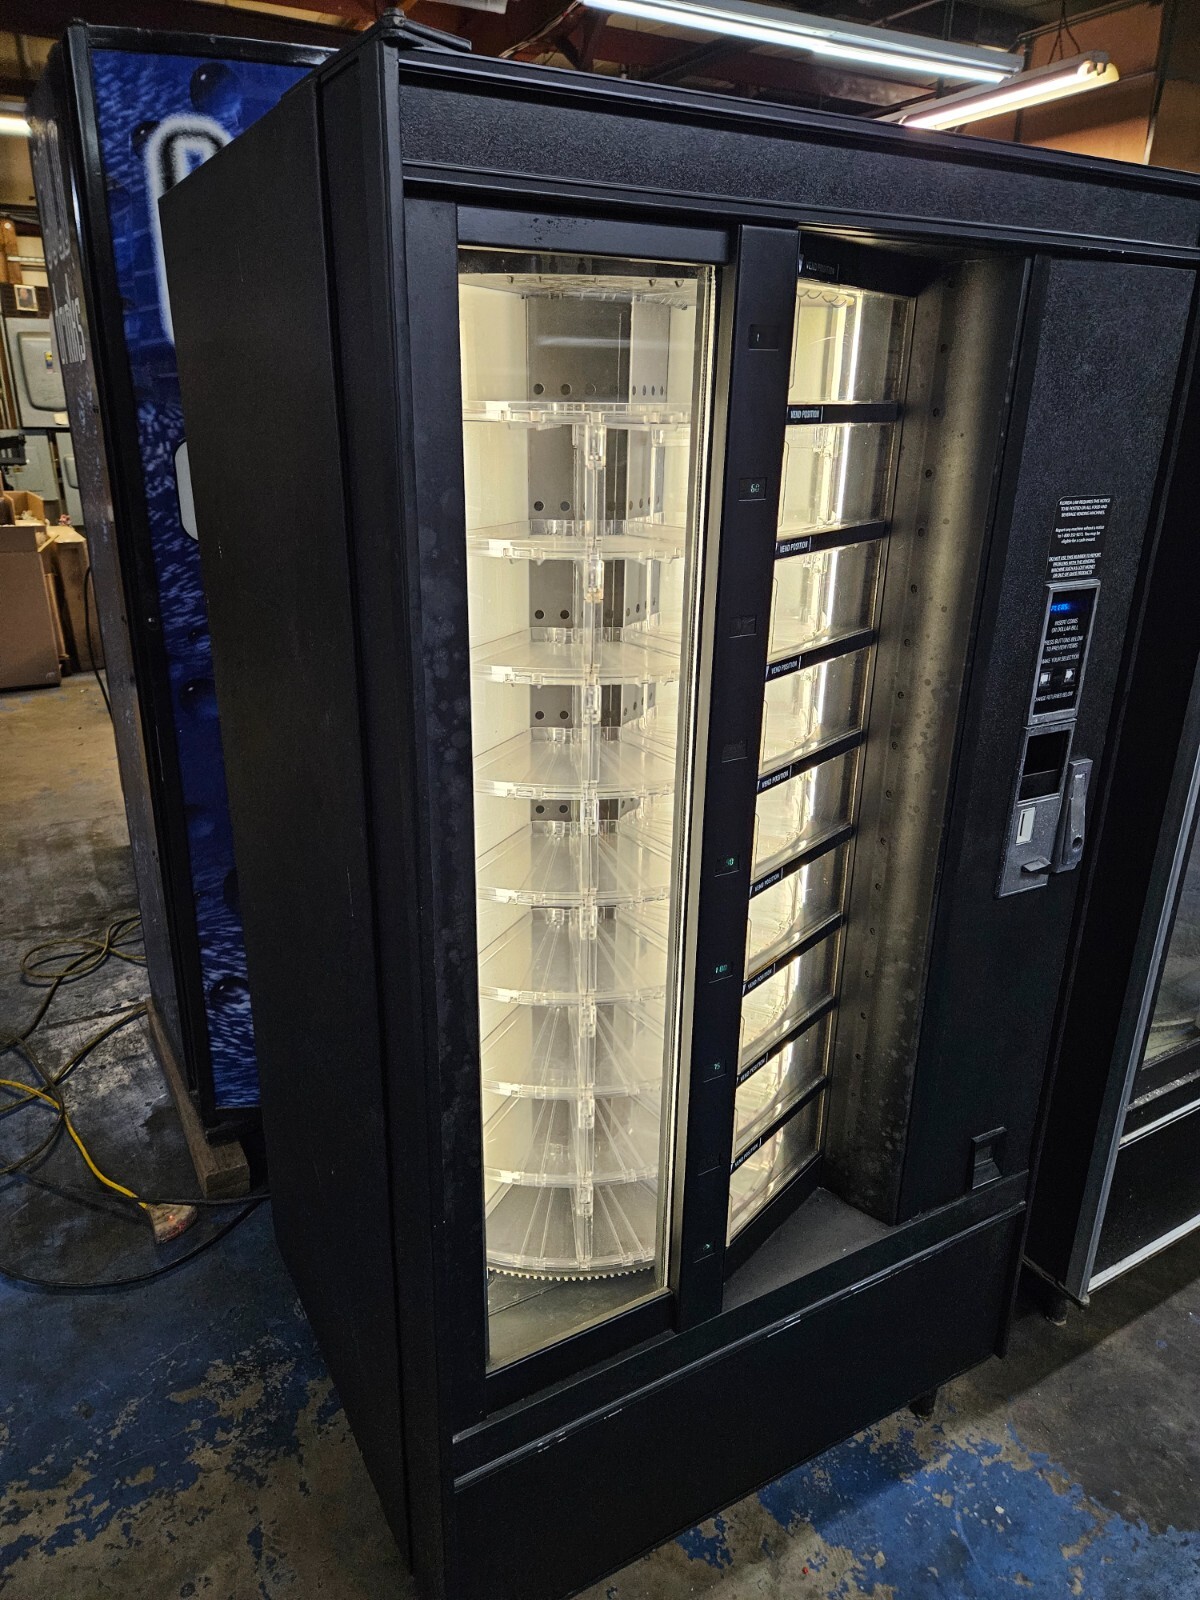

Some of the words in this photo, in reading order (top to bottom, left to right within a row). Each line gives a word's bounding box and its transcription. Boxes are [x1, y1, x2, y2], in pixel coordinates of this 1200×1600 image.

[790, 410, 801, 418] VEND
[802, 410, 820, 418] POSITION
[780, 544, 790, 553] VEND
[790, 541, 808, 550] POSITION
[771, 666, 780, 674] VEND
[782, 660, 798, 670] POSITION
[762, 778, 771, 788] VEND
[772, 770, 788, 783] POSITION
